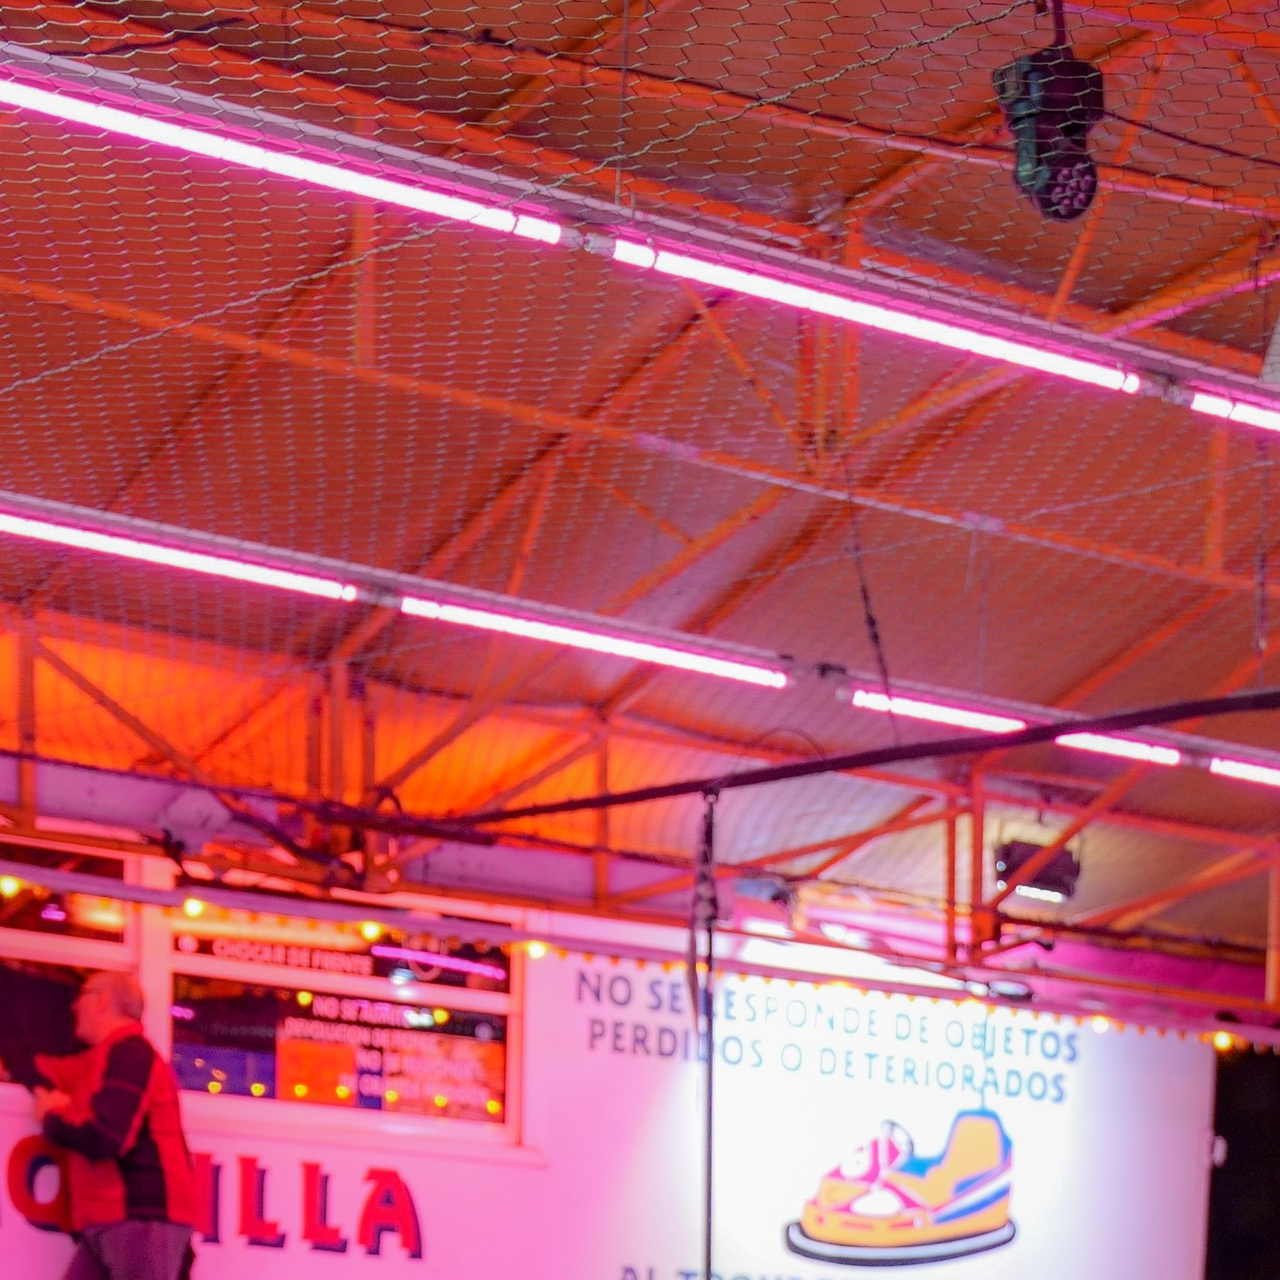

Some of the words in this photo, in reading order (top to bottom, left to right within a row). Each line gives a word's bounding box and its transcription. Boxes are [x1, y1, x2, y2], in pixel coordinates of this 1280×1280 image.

[575, 970, 633, 1006] NO
[648, 977, 683, 1014] SE
[895, 1012, 929, 1044] DE
[945, 1018, 1079, 1064] OBJETOS
[780, 1043, 803, 1071] O
[819, 1047, 1065, 1103] DETERIORADOS
